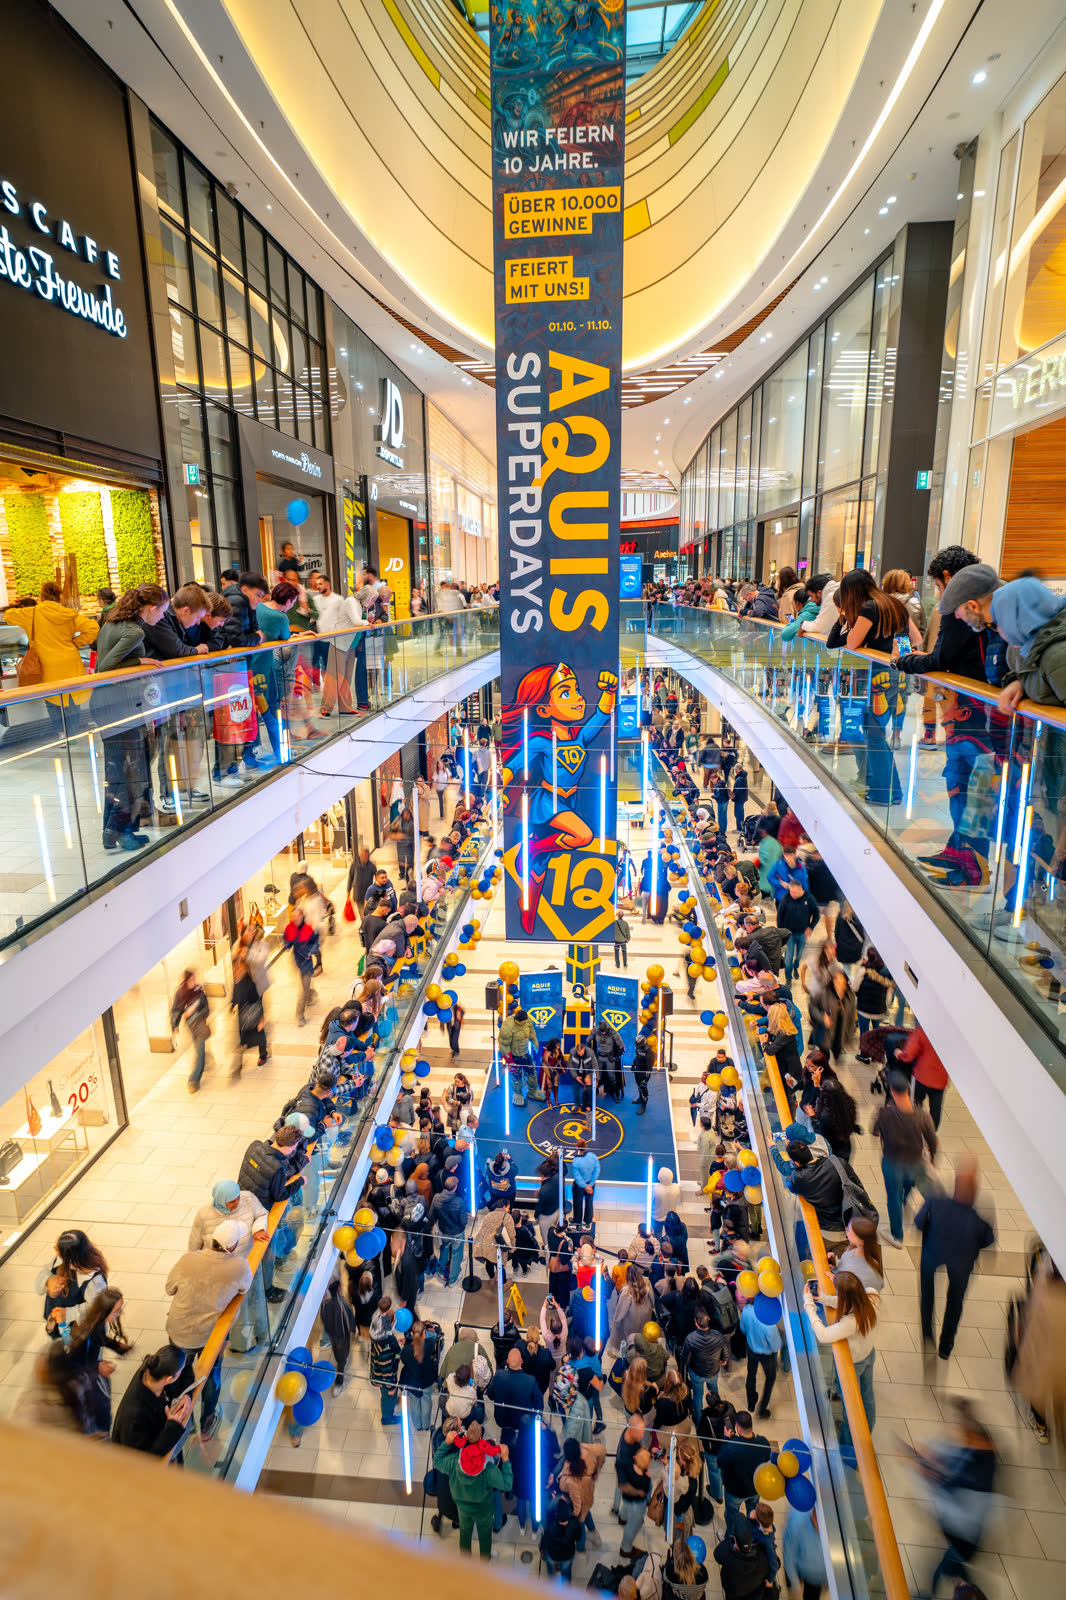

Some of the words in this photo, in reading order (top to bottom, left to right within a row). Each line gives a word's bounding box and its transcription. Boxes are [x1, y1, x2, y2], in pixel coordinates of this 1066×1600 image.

[503, 130, 539, 149] WIR
[545, 124, 614, 146] FEIERN
[503, 156, 523, 174] 10
[529, 152, 599, 172] JAHRE.
[509, 196, 556, 215] ÜBER
[561, 193, 618, 210] 10.000
[509, 216, 588, 234] GEWINNE
[510, 261, 568, 277] FEIERT
[28, 246, 127, 338] Freunde
[510, 284, 539, 299] MIT
[545, 282, 584, 297] UNS!
[548, 321, 577, 332] 01.10.
[587, 320, 612, 331] 11.10.
[382, 377, 404, 449] JD
[506, 352, 543, 634] SUPERDAYS
[530, 350, 611, 632] AQUIS
[384, 557, 404, 572] JD
[653, 550, 677, 559] Aachen
[531, 982, 551, 990] AQUIS
[607, 985, 626, 993] AQUIS
[68, 1072, 98, 1115] 20%
